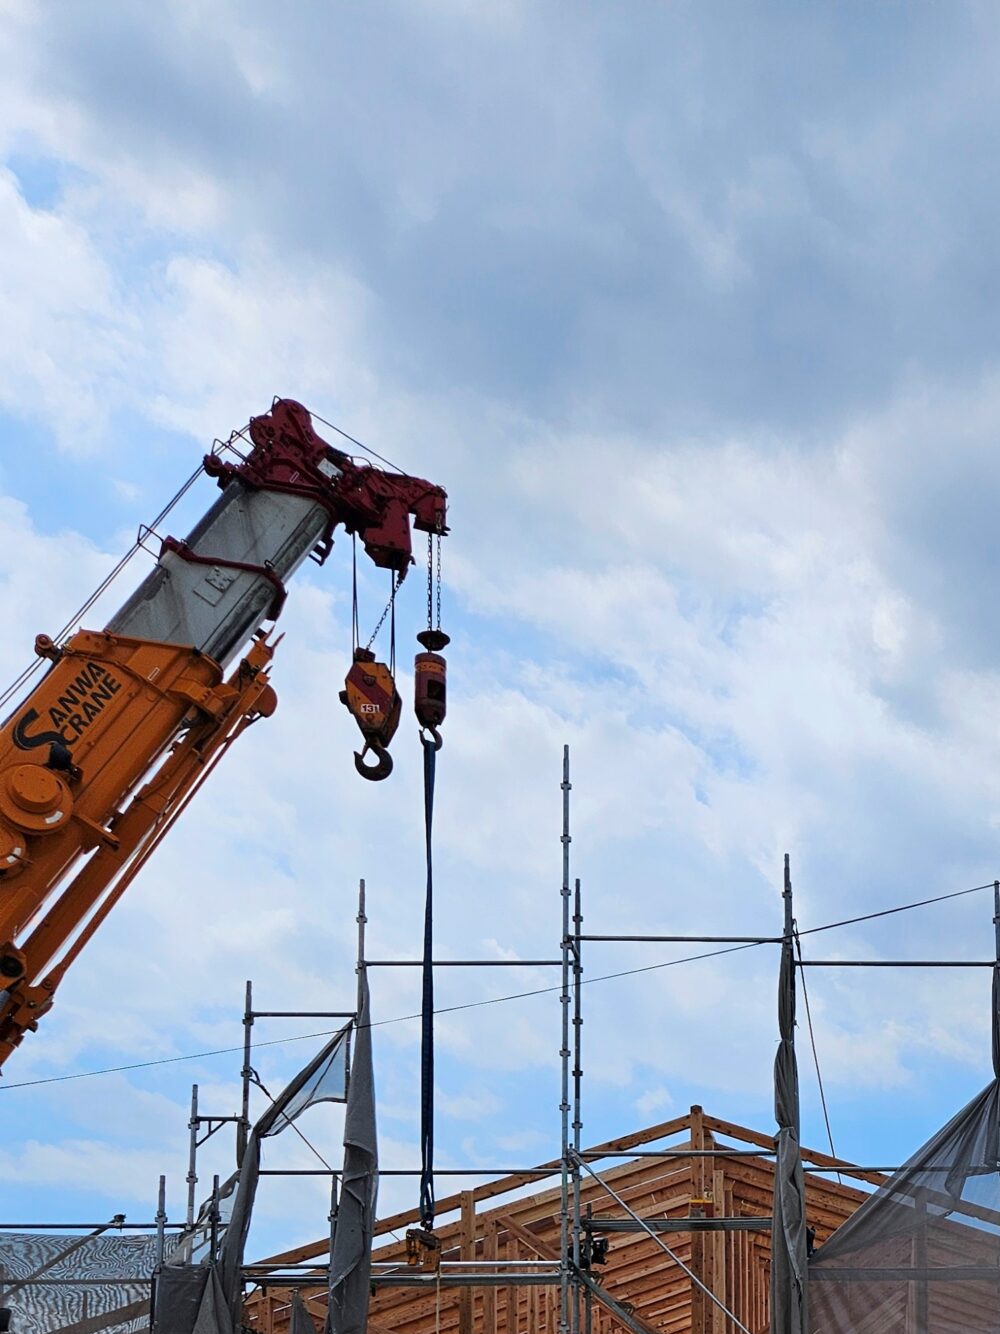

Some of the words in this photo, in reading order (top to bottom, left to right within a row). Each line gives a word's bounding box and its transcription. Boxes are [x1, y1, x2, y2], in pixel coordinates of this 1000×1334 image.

[12, 661, 107, 751] SANWA
[60, 672, 122, 746] CRANE
[361, 704, 380, 713] 131
